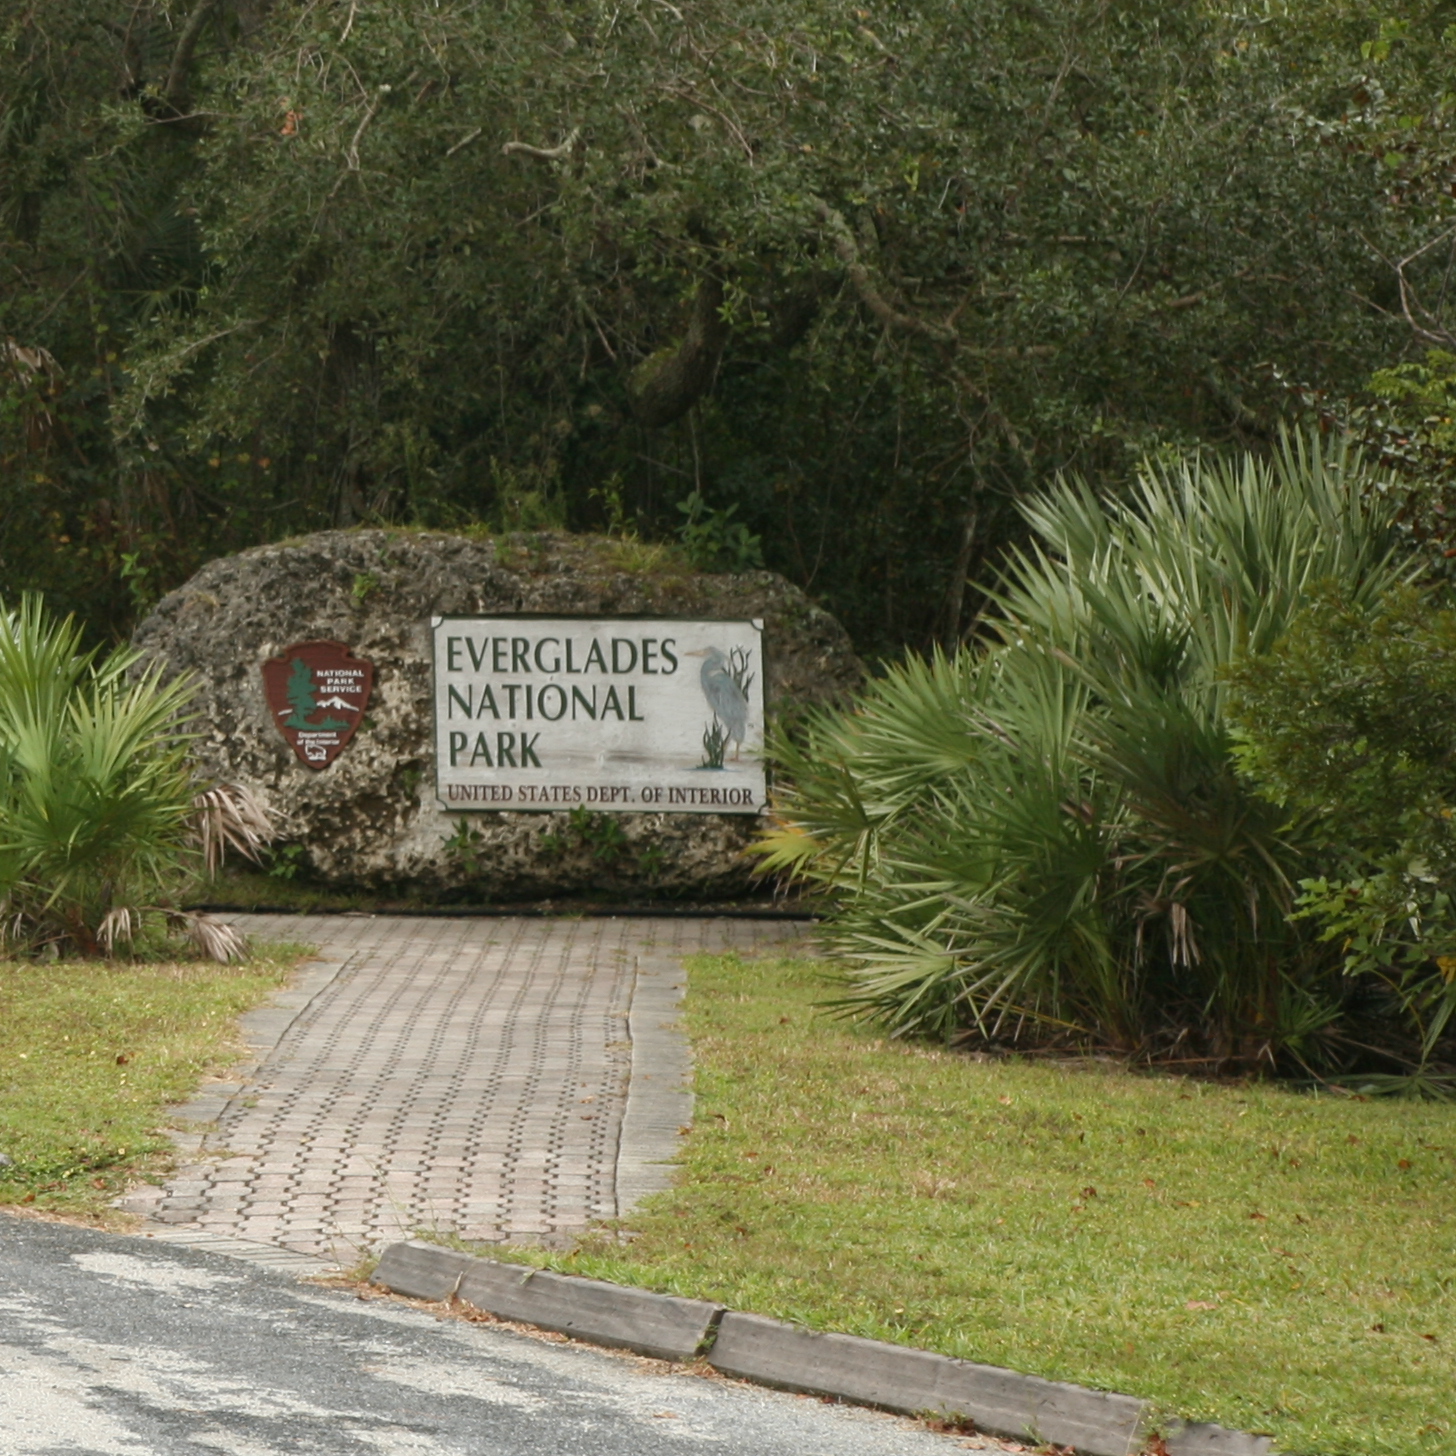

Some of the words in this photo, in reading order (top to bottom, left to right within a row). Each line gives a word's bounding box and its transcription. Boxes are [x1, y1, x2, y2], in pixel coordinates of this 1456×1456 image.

[447, 636, 678, 675] EVERGLADES
[320, 685, 362, 693] SERVICE
[448, 683, 645, 721] NATIONAL
[449, 731, 543, 768] PARK
[447, 783, 513, 801] UNITED
[518, 784, 582, 802] STATES
[587, 785, 636, 804] DEPT.
[641, 786, 664, 804] OF
[668, 787, 754, 806] INTERIOR
